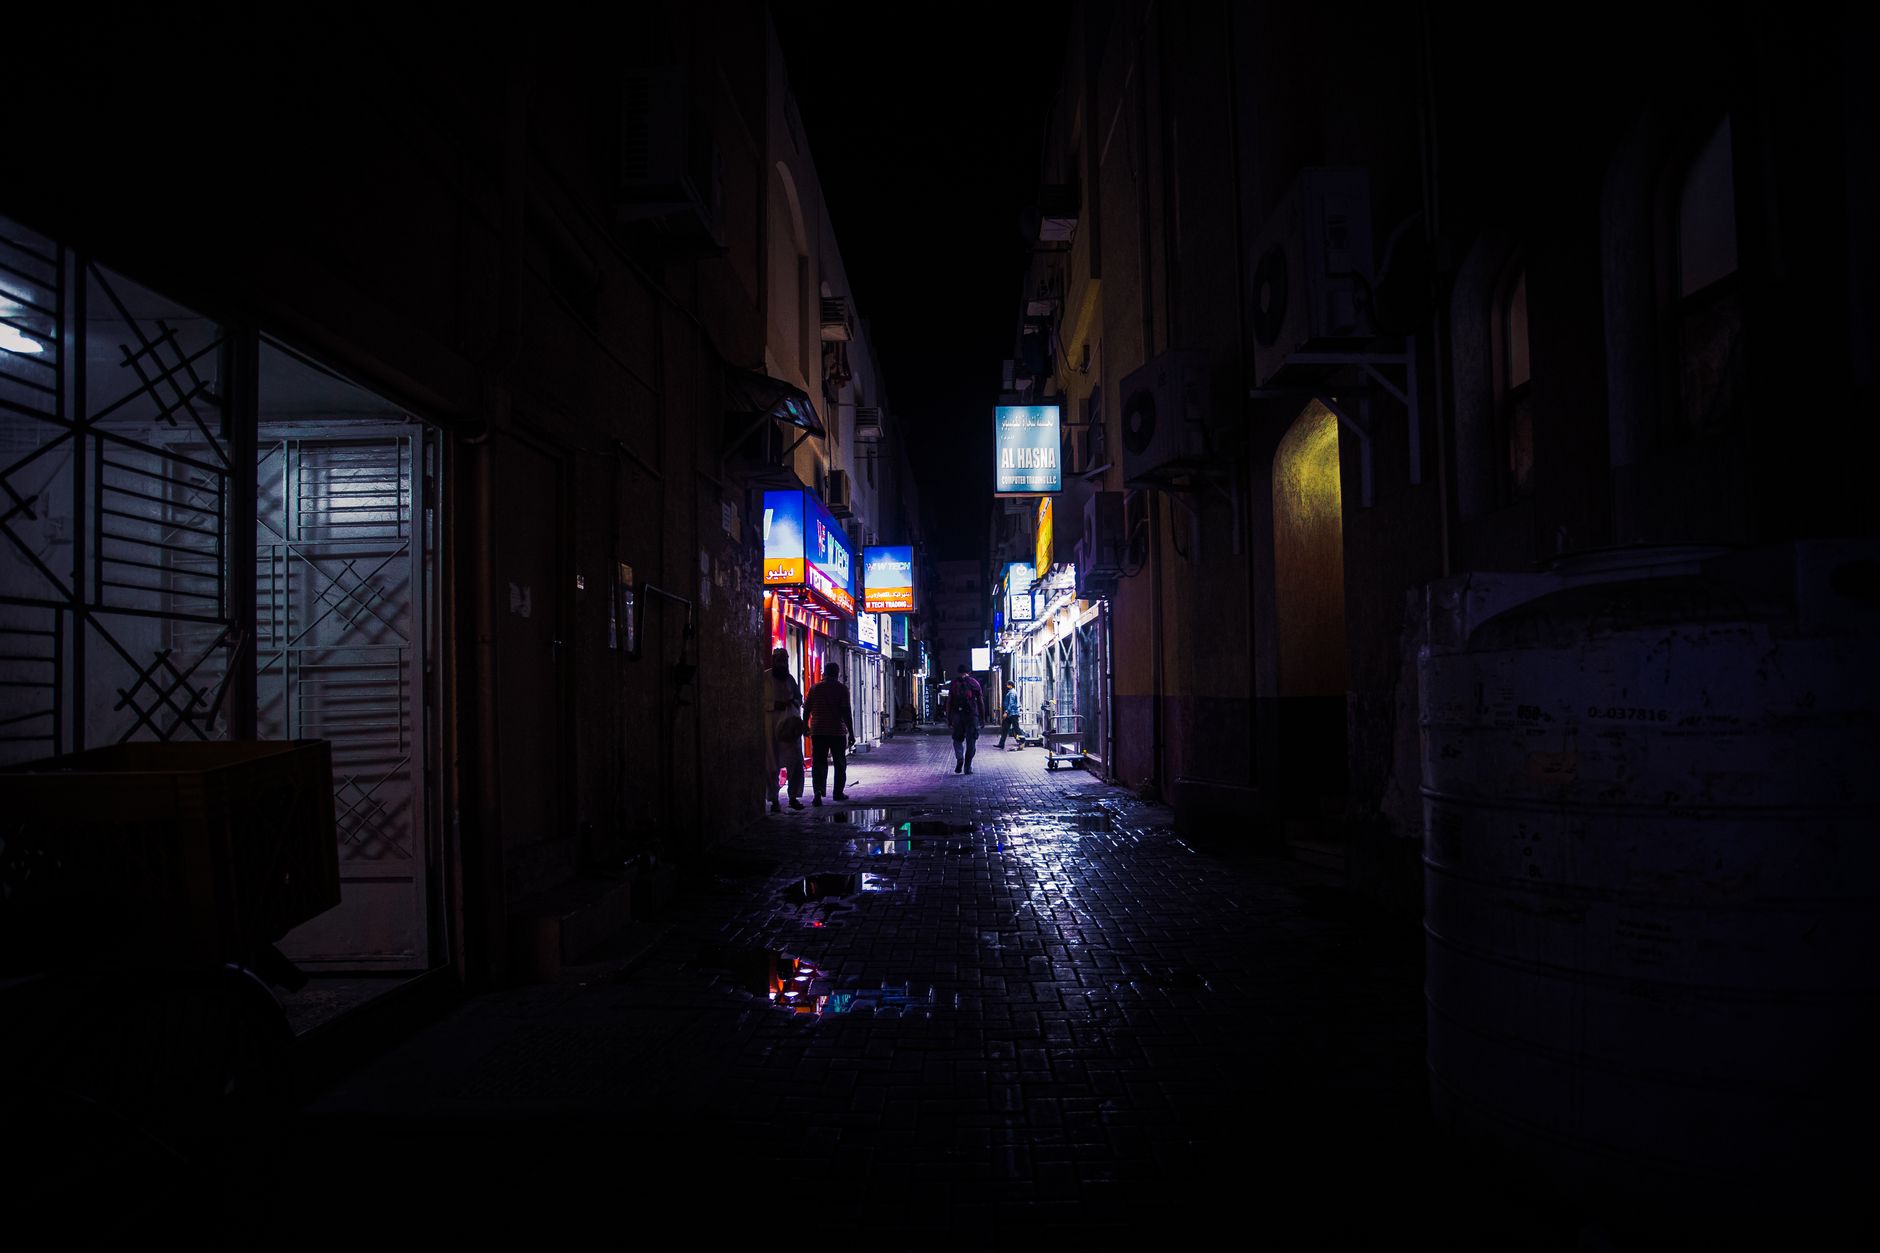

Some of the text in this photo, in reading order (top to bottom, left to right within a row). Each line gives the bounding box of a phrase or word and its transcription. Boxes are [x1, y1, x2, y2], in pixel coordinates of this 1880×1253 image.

[1001, 447, 1056, 469] AL HASNA
[766, 565, 794, 580] دبليو
[887, 562, 911, 571] TECH
[871, 601, 885, 609] TECH
[885, 600, 907, 608] TRADING
